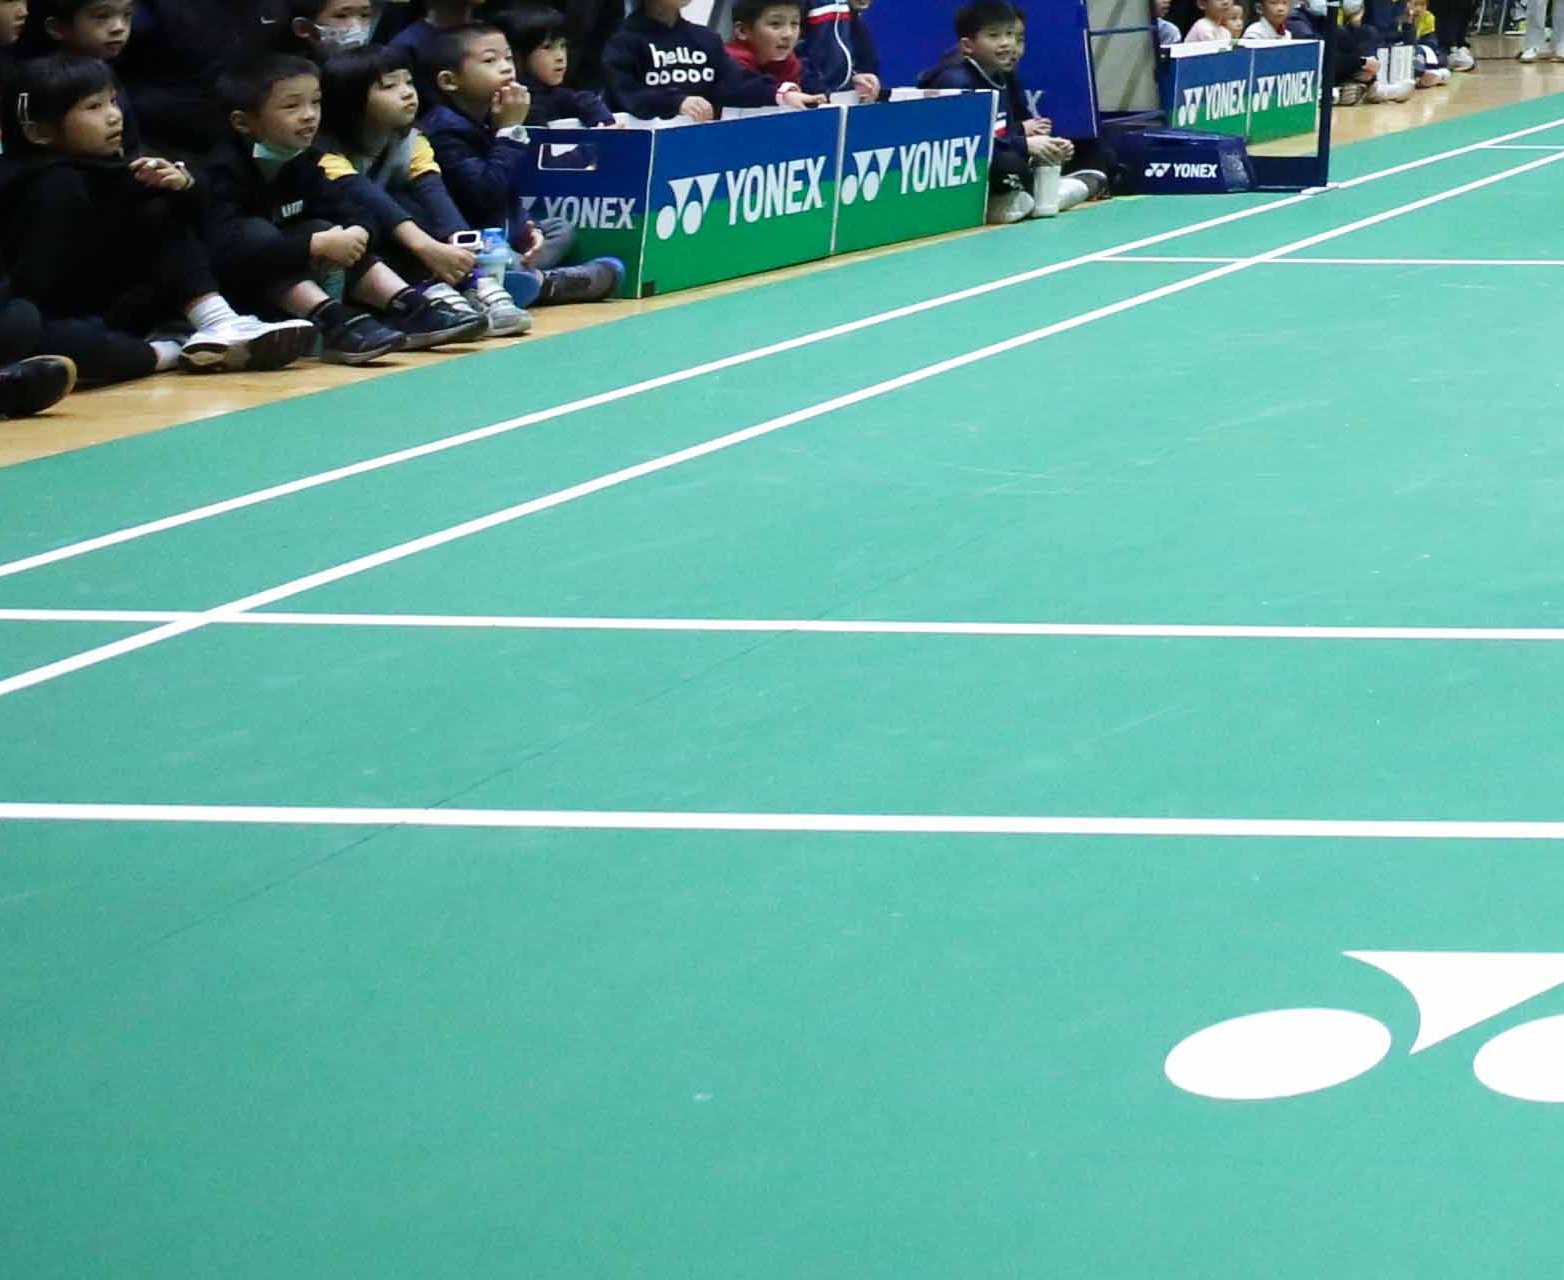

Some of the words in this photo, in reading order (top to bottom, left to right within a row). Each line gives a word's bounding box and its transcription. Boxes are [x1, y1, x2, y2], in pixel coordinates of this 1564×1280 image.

[645, 44, 708, 68] hello
[1204, 80, 1248, 120] YONEX
[1276, 70, 1316, 107] YONEX
[899, 135, 981, 194] YONEX
[1172, 163, 1219, 178] YONEX
[725, 155, 827, 226] YONEX
[544, 195, 636, 231] YONEX
